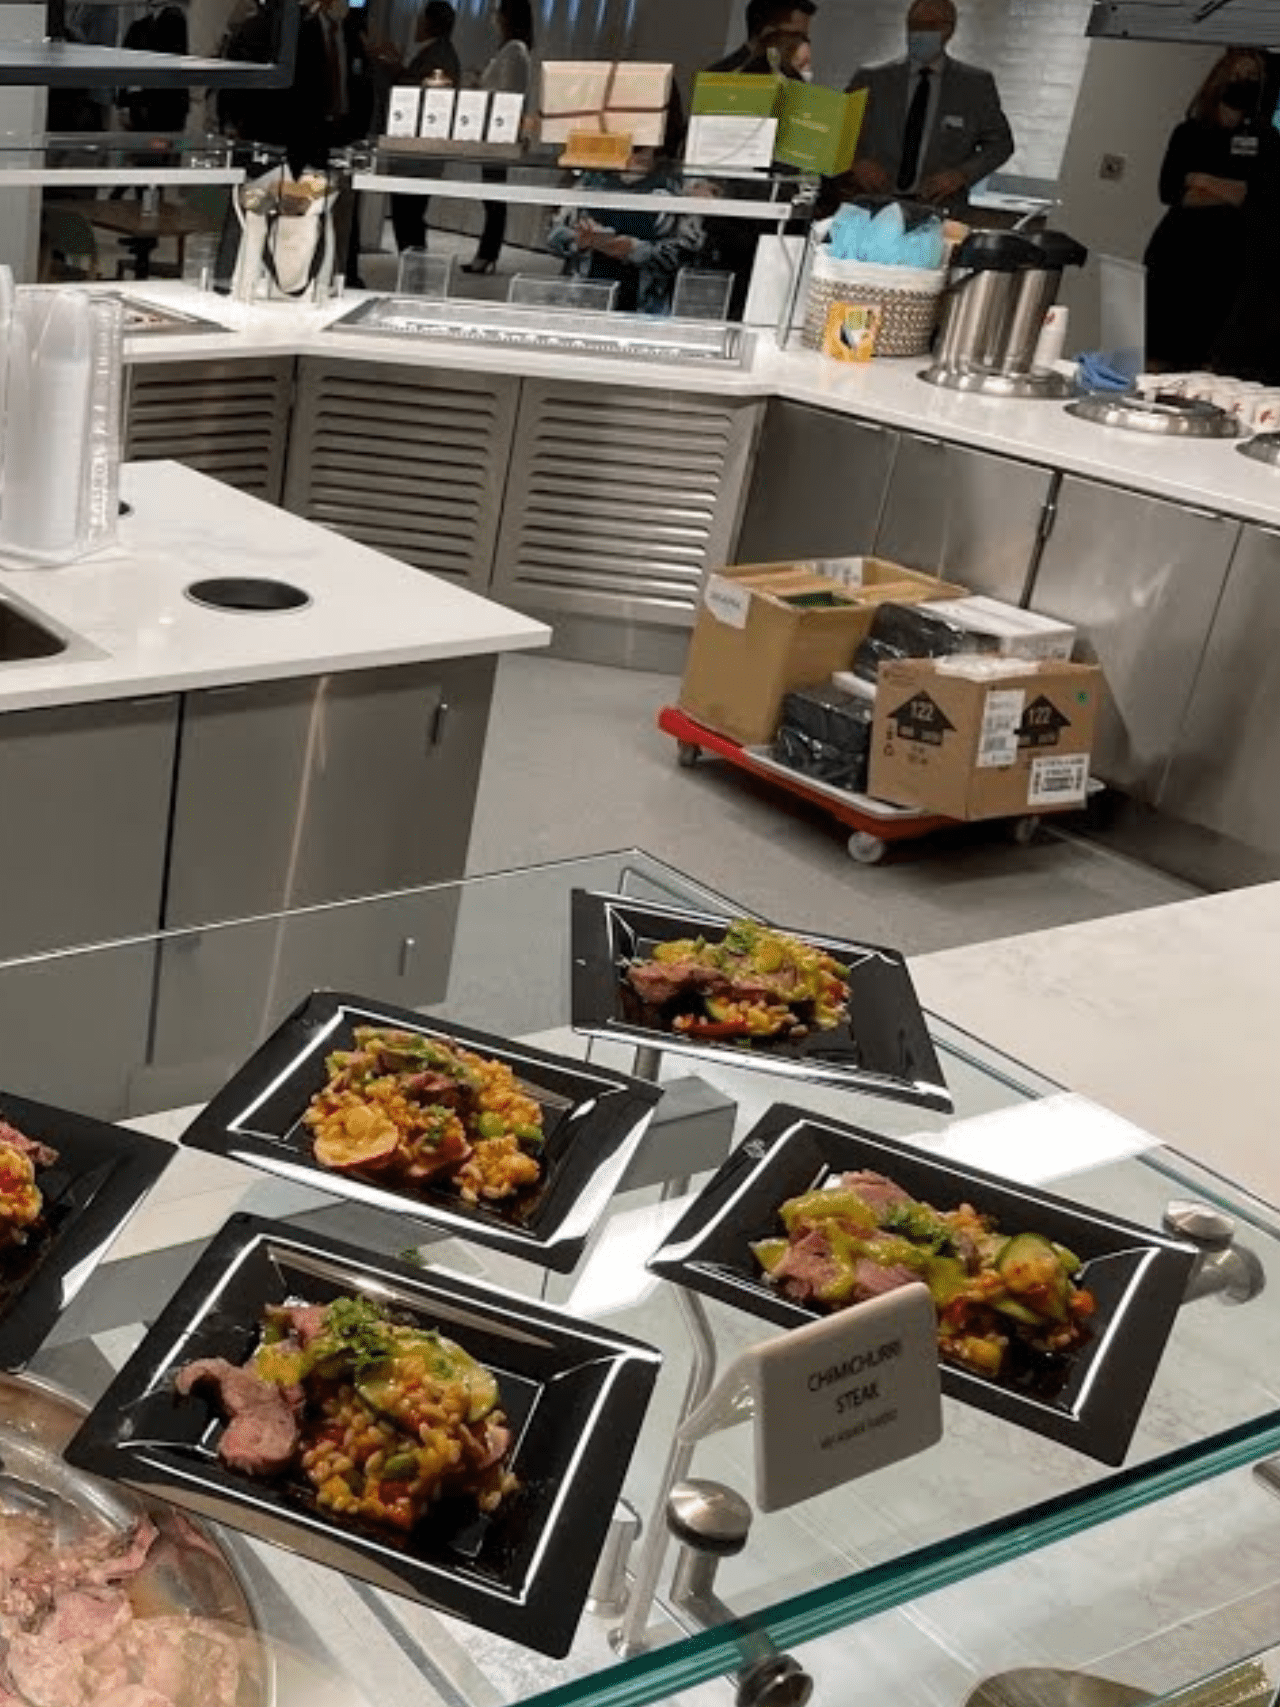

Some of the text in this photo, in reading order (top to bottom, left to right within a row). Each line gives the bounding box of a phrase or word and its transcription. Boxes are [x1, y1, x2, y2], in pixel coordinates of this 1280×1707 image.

[910, 700, 934, 721] 122
[1029, 706, 1052, 725] 122
[807, 1339, 902, 1392] CHIMICHURRI
[835, 1381, 880, 1414] STEAK
